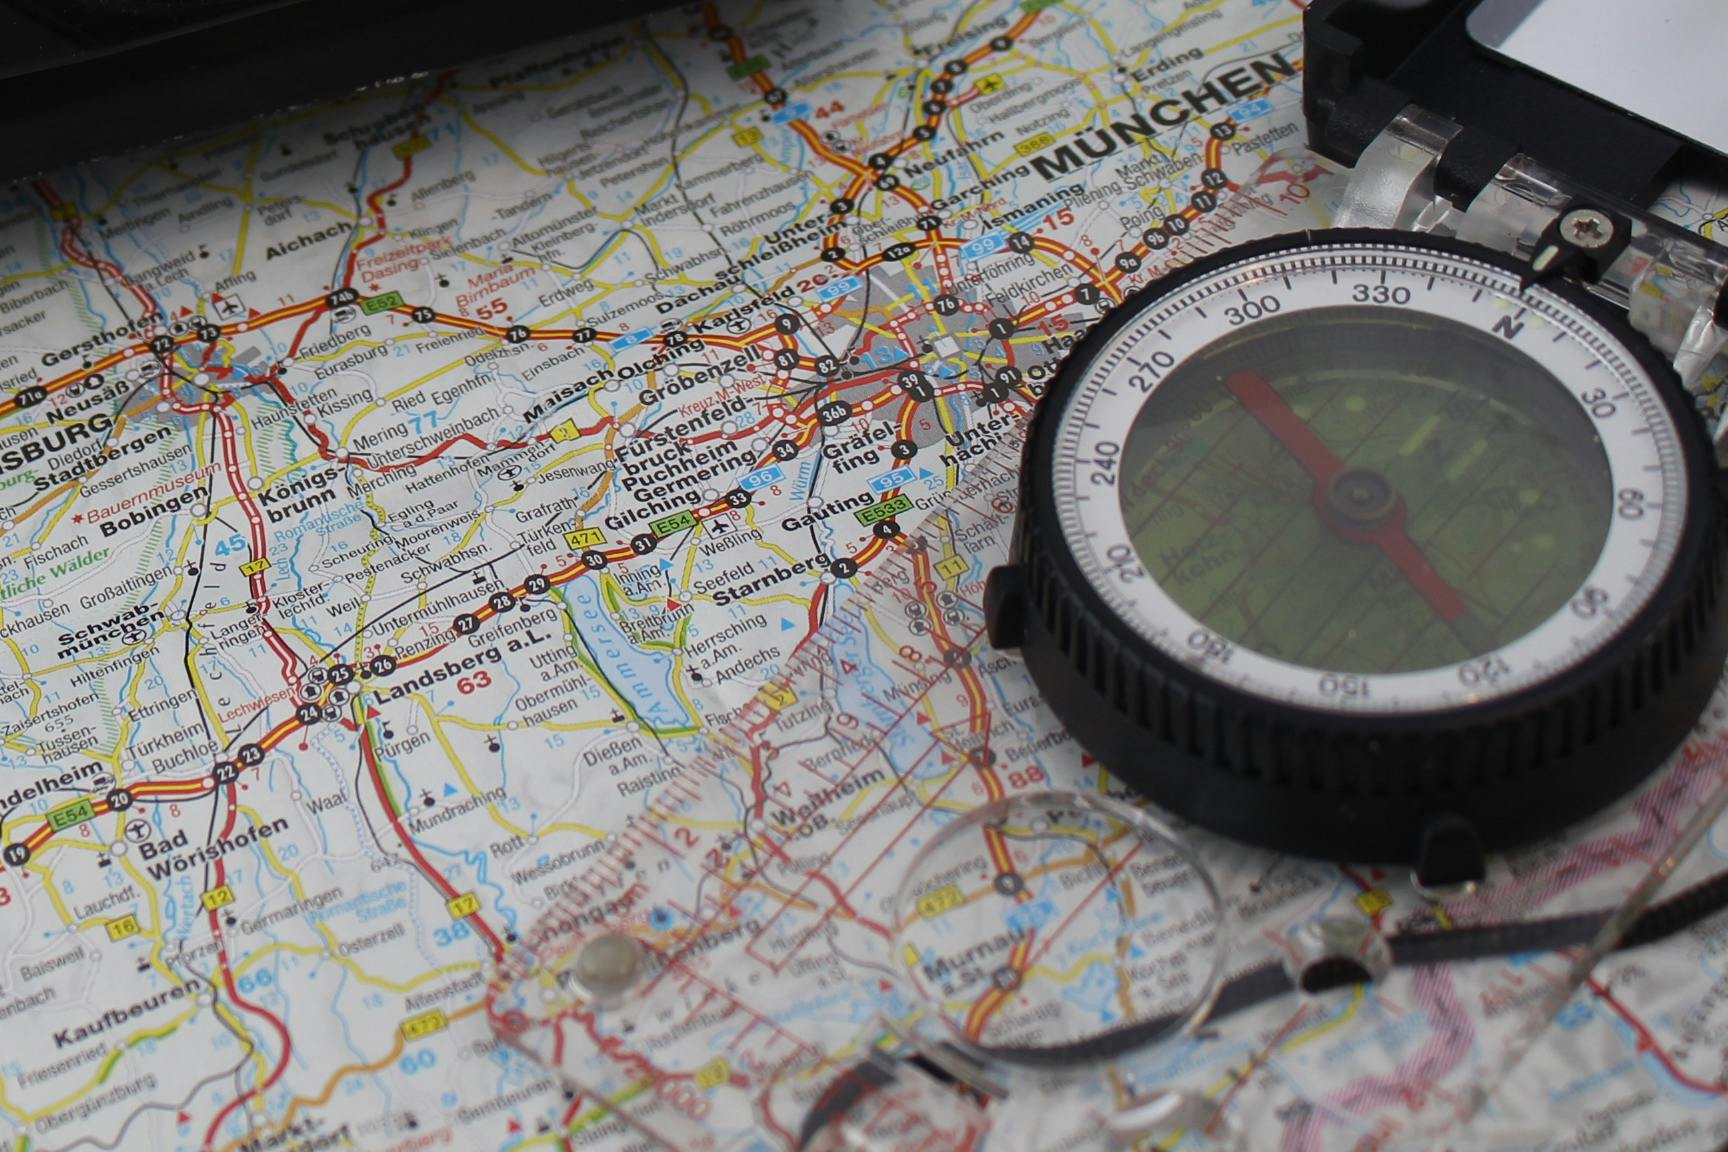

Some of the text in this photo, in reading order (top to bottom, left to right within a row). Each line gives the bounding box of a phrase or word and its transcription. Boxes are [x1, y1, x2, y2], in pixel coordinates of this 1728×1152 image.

[1131, 47, 1203, 83] Erding
[1030, 53, 1299, 179] MÜNCHEN
[1232, 122, 1298, 155] Pastetten
[931, 165, 1030, 211] Garching
[983, 182, 1084, 229] Ismaning
[266, 222, 352, 261] Aichach
[715, 221, 847, 281] schleißheim
[365, 297, 397, 311] E52
[476, 299, 509, 319] 55
[694, 285, 795, 334] Karlsfeld
[1224, 296, 1282, 329] 300
[1352, 284, 1412, 306] 330
[42, 312, 163, 367] Gersthofen
[298, 324, 371, 360] Friedberg
[1492, 315, 1524, 340] N
[638, 348, 761, 406] Gröbenzell
[1127, 349, 1178, 399] 270
[46, 381, 130, 424] Neusäß
[318, 388, 373, 418] Kissing
[523, 368, 614, 424] Maisach
[1581, 387, 1617, 421] 30
[354, 423, 408, 451] Mering
[369, 407, 500, 470] Unterschweinbach
[33, 426, 171, 493] Stadtbergen
[81, 444, 193, 499] Gessertshausen
[622, 440, 738, 493] Puchheim
[632, 449, 758, 504] Germering
[1092, 439, 1120, 489] 240
[88, 461, 221, 524] Bauernmuseum
[347, 464, 416, 499] Merching
[100, 487, 208, 538] Bobingen
[604, 489, 703, 532] Gilching
[782, 493, 873, 531] Gauting
[863, 500, 907, 521] E533
[1616, 486, 1645, 521] 60
[569, 531, 601, 546] 471
[655, 516, 690, 536] E54
[24, 534, 88, 569] Fischach
[1106, 542, 1146, 584] 210
[80, 565, 173, 611] Großaitingen
[694, 562, 754, 595] Seefeld
[712, 553, 831, 607] Starnberg
[58, 601, 159, 646] Schwab-
[1570, 586, 1613, 621] 90
[58, 609, 165, 660] münchen
[468, 610, 558, 648] Greifenberg
[70, 646, 160, 688] Hiltenfingen
[374, 628, 552, 705] Landsberg a.L.
[457, 672, 492, 694] 63
[716, 646, 780, 684] Andechs
[1318, 671, 1371, 700] 150
[1458, 653, 1513, 688] 120
[54, 805, 89, 828] E54
[140, 831, 187, 860] Bad
[148, 817, 289, 882] Wörishofen
[925, 927, 1027, 982] Murnau
[54, 980, 199, 1048] Kaufbeuren
